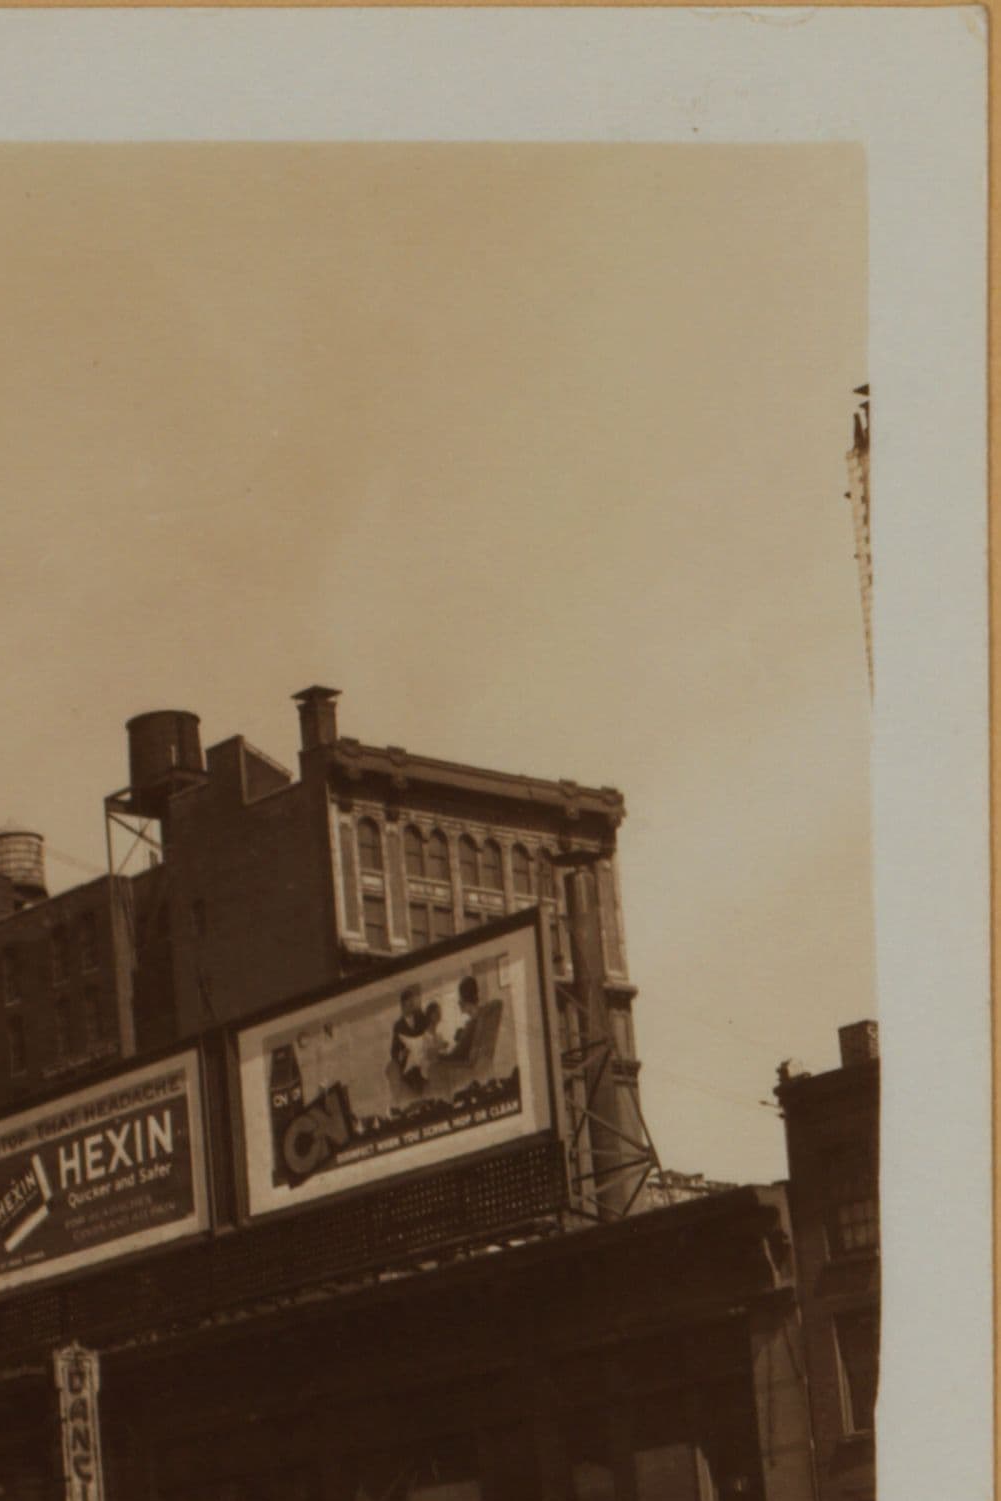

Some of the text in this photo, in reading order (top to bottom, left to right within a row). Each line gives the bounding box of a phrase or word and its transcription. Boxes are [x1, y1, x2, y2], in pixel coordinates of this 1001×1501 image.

[58, 1109, 173, 1191] HEXIN
[114, 1174, 136, 1193] and
[138, 1162, 173, 1185] Safer
